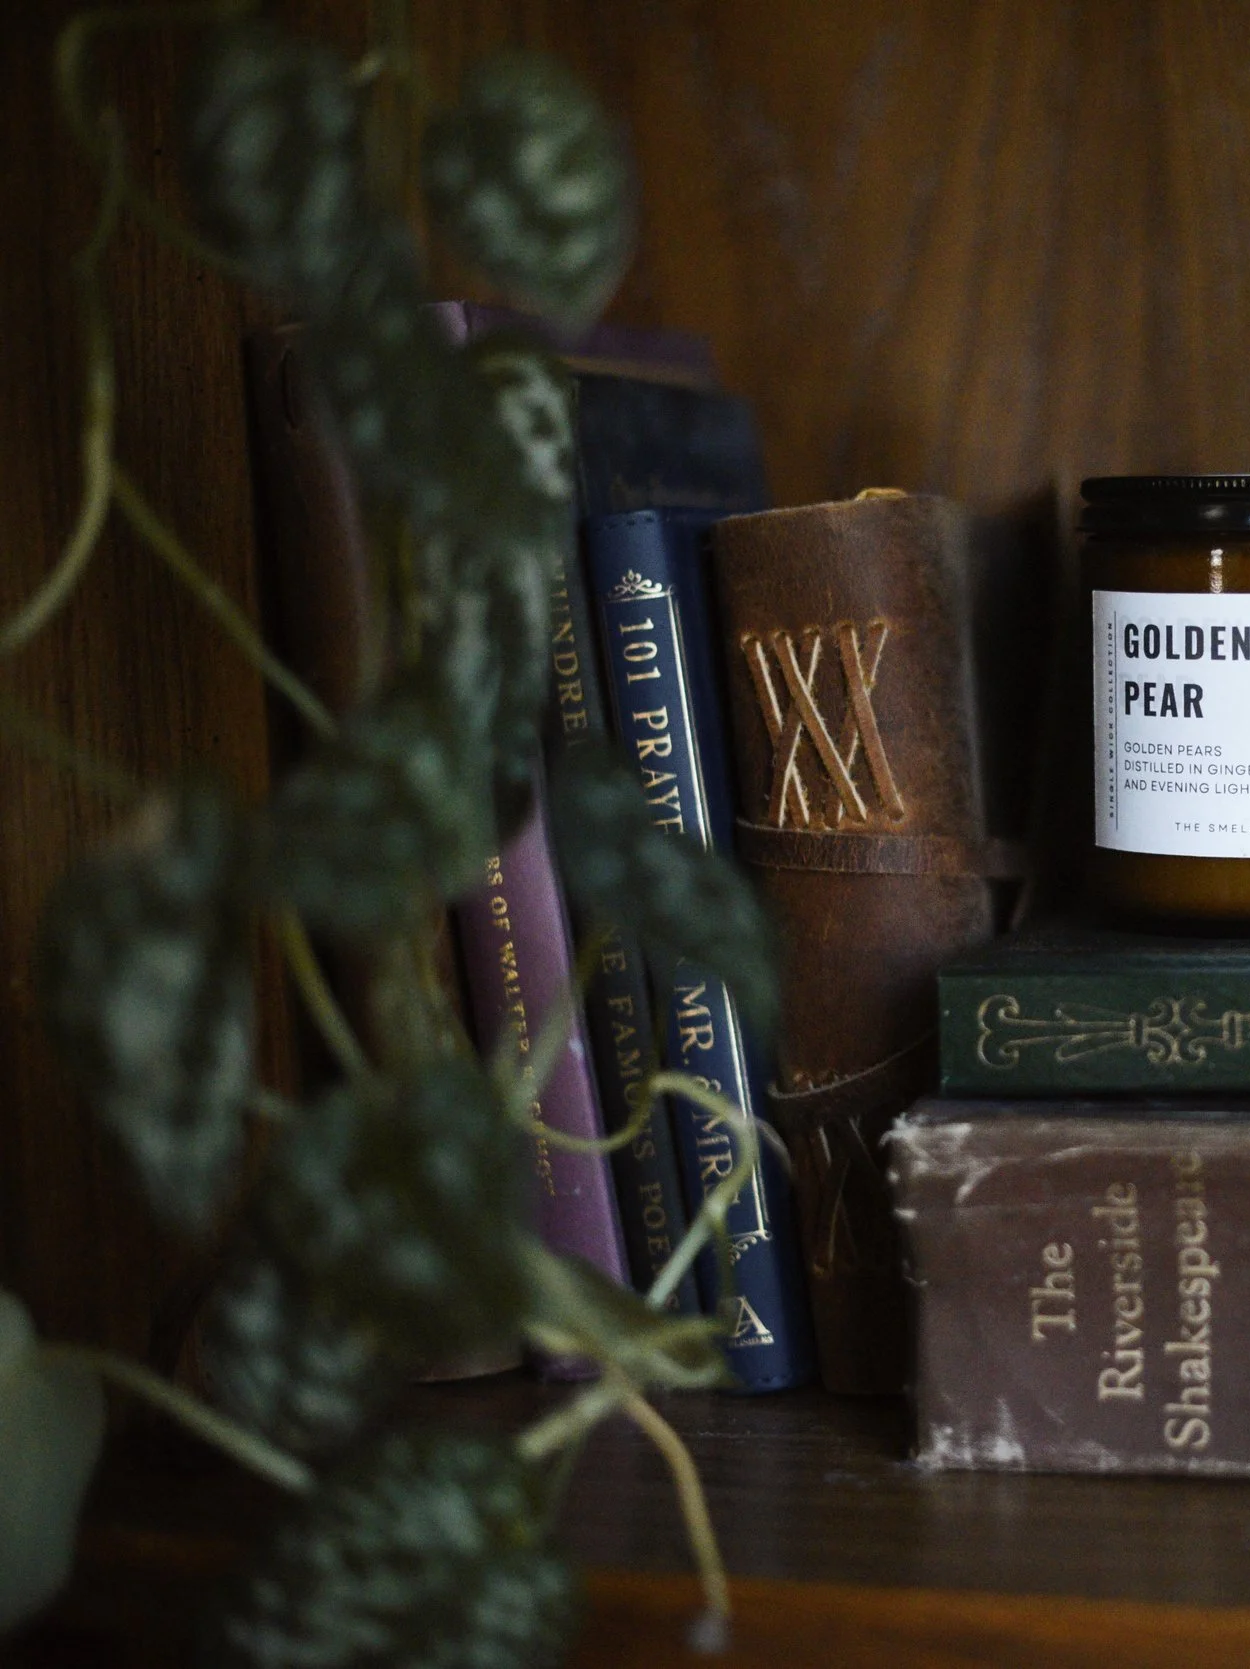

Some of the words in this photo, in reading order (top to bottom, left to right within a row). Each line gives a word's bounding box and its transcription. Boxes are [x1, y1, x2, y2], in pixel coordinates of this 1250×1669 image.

[619, 617, 662, 685] 101
[1124, 681, 1204, 719] PEAR
[1124, 741, 1173, 756] GOLDEN
[1178, 744, 1223, 757] PEARS
[1124, 760, 1184, 775] DISTILLED
[1189, 763, 1203, 775] IN
[1124, 778, 1148, 792] AND
[1151, 781, 1210, 794] EVENING
[1174, 822, 1201, 833] THE
[490, 896, 511, 931] OF
[674, 981, 715, 1067] MR.
[1028, 1240, 1077, 1343] The
[1092, 1180, 1145, 1403] Riverside
[1164, 1148, 1222, 1452] Shakespeare
